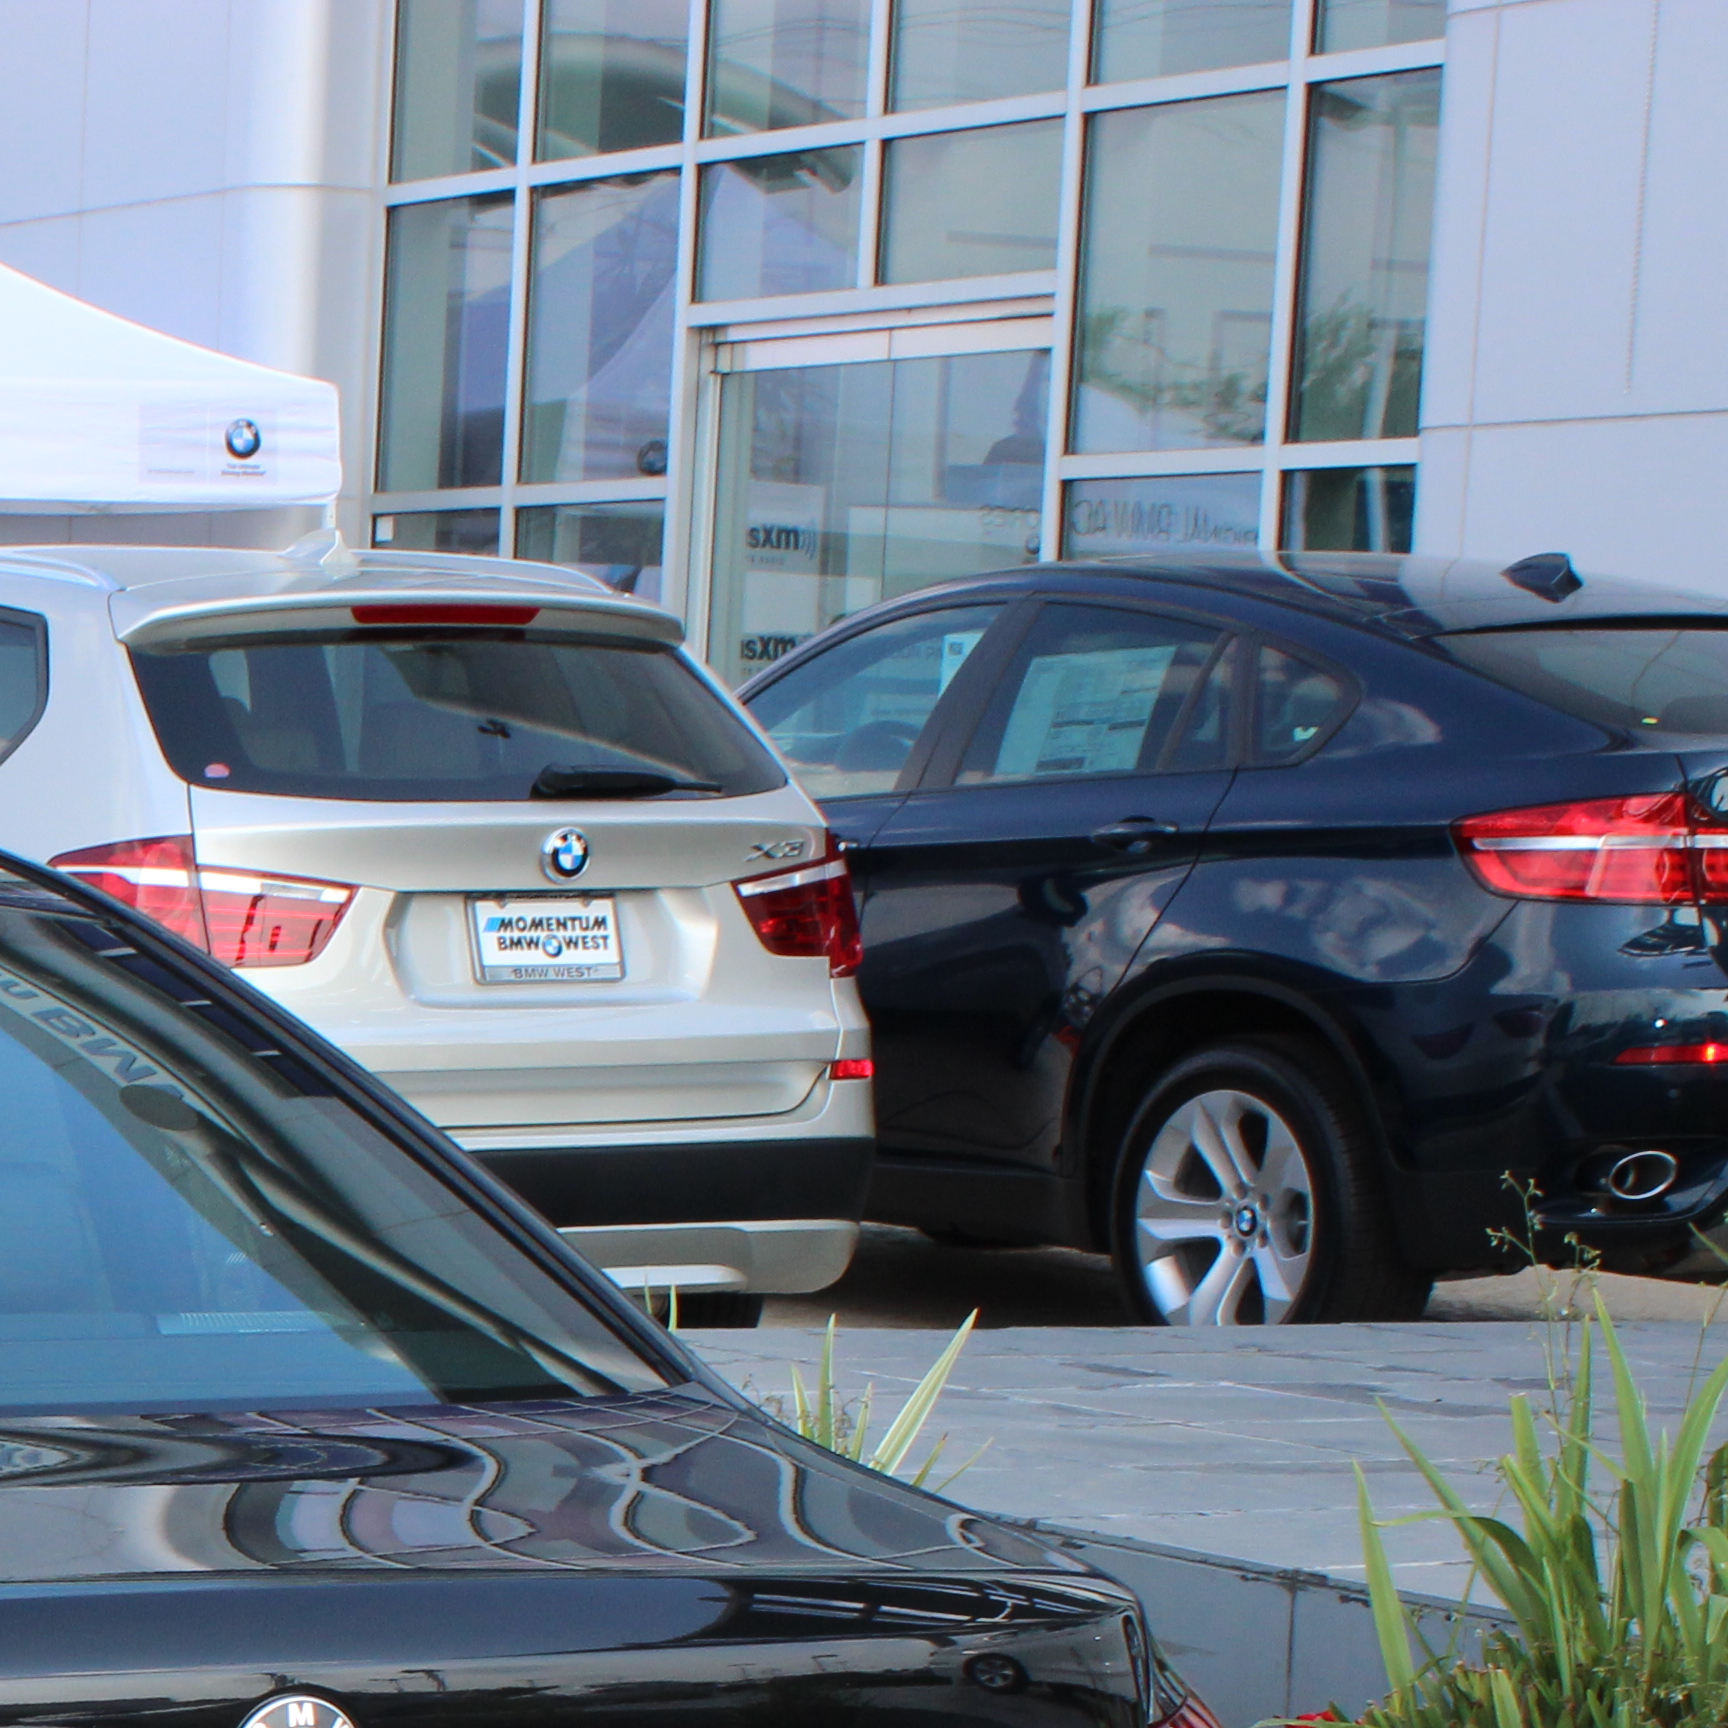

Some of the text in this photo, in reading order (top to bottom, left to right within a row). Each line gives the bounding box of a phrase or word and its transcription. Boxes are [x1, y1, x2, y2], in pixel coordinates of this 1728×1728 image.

[744, 839, 804, 861] X3
[496, 915, 608, 932] MOMENTUM
[497, 935, 610, 952] BMW WEST
